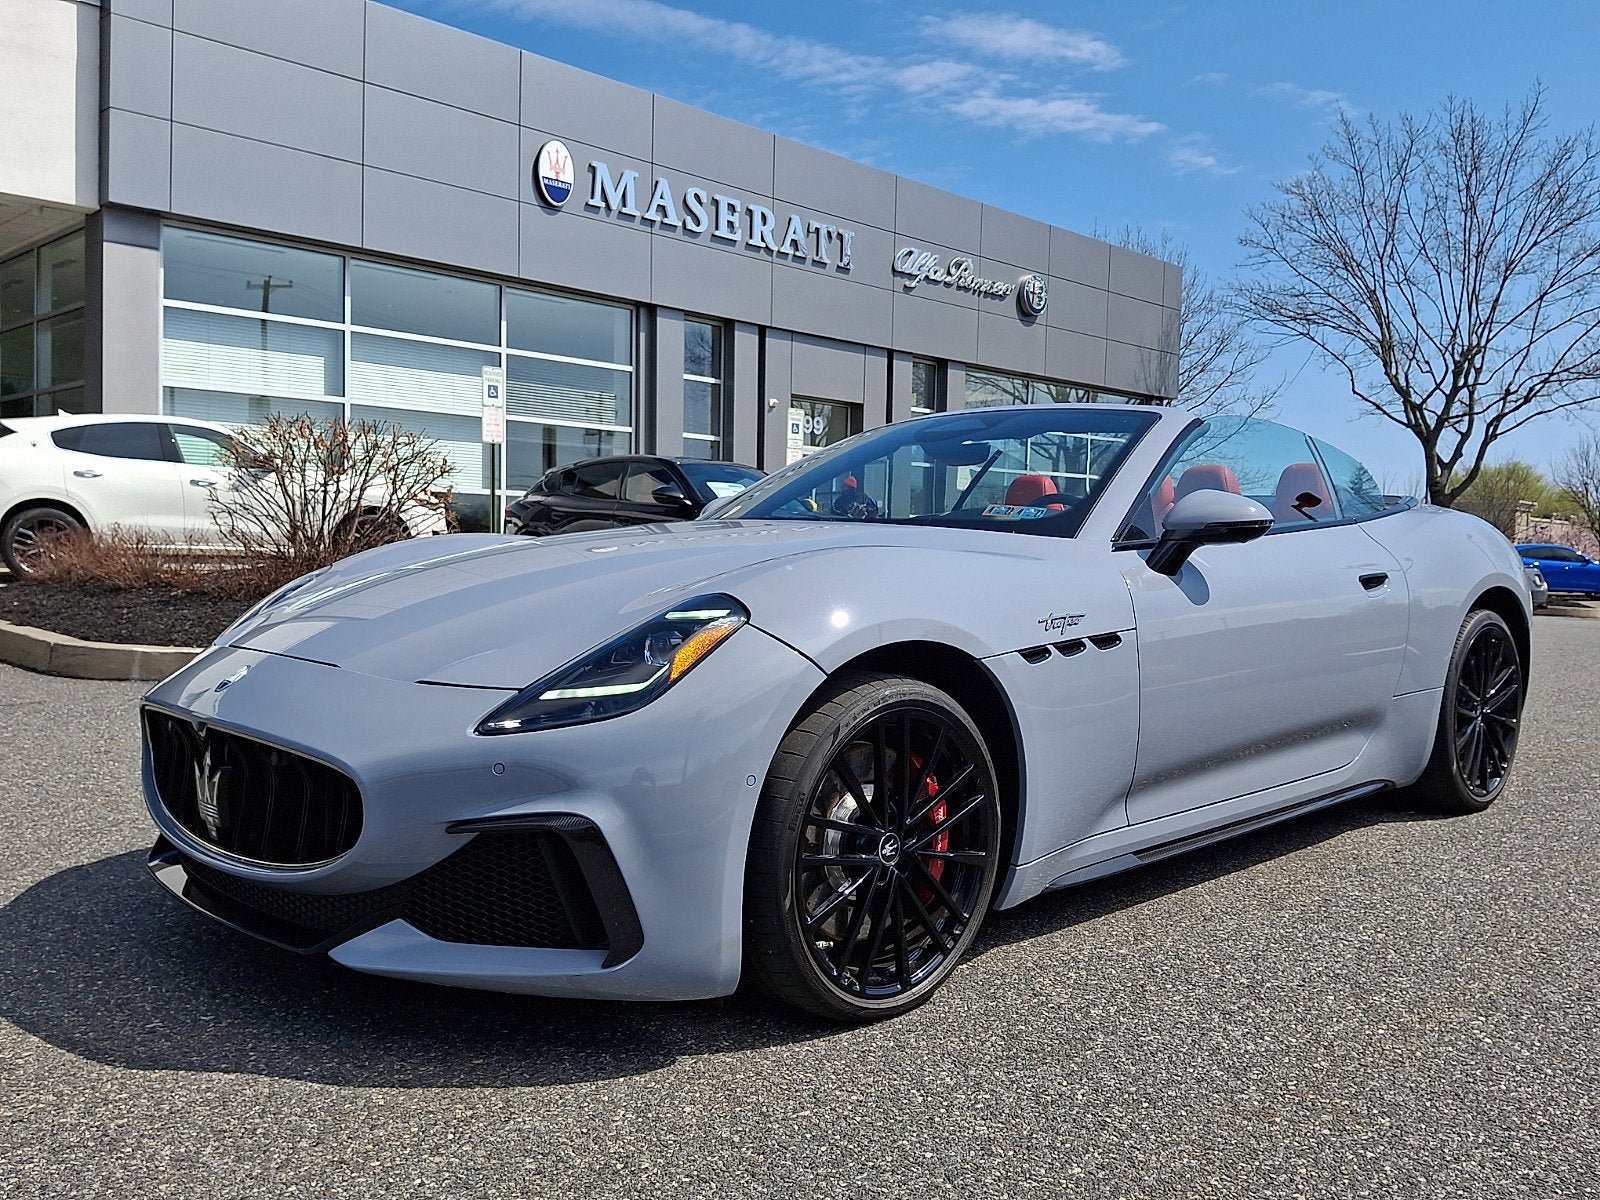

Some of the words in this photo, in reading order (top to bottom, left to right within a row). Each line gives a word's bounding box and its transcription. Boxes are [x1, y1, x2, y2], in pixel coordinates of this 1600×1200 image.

[587, 160, 855, 269] MASERATI
[894, 247, 944, 288] Alfa
[944, 256, 1016, 297] Romeo
